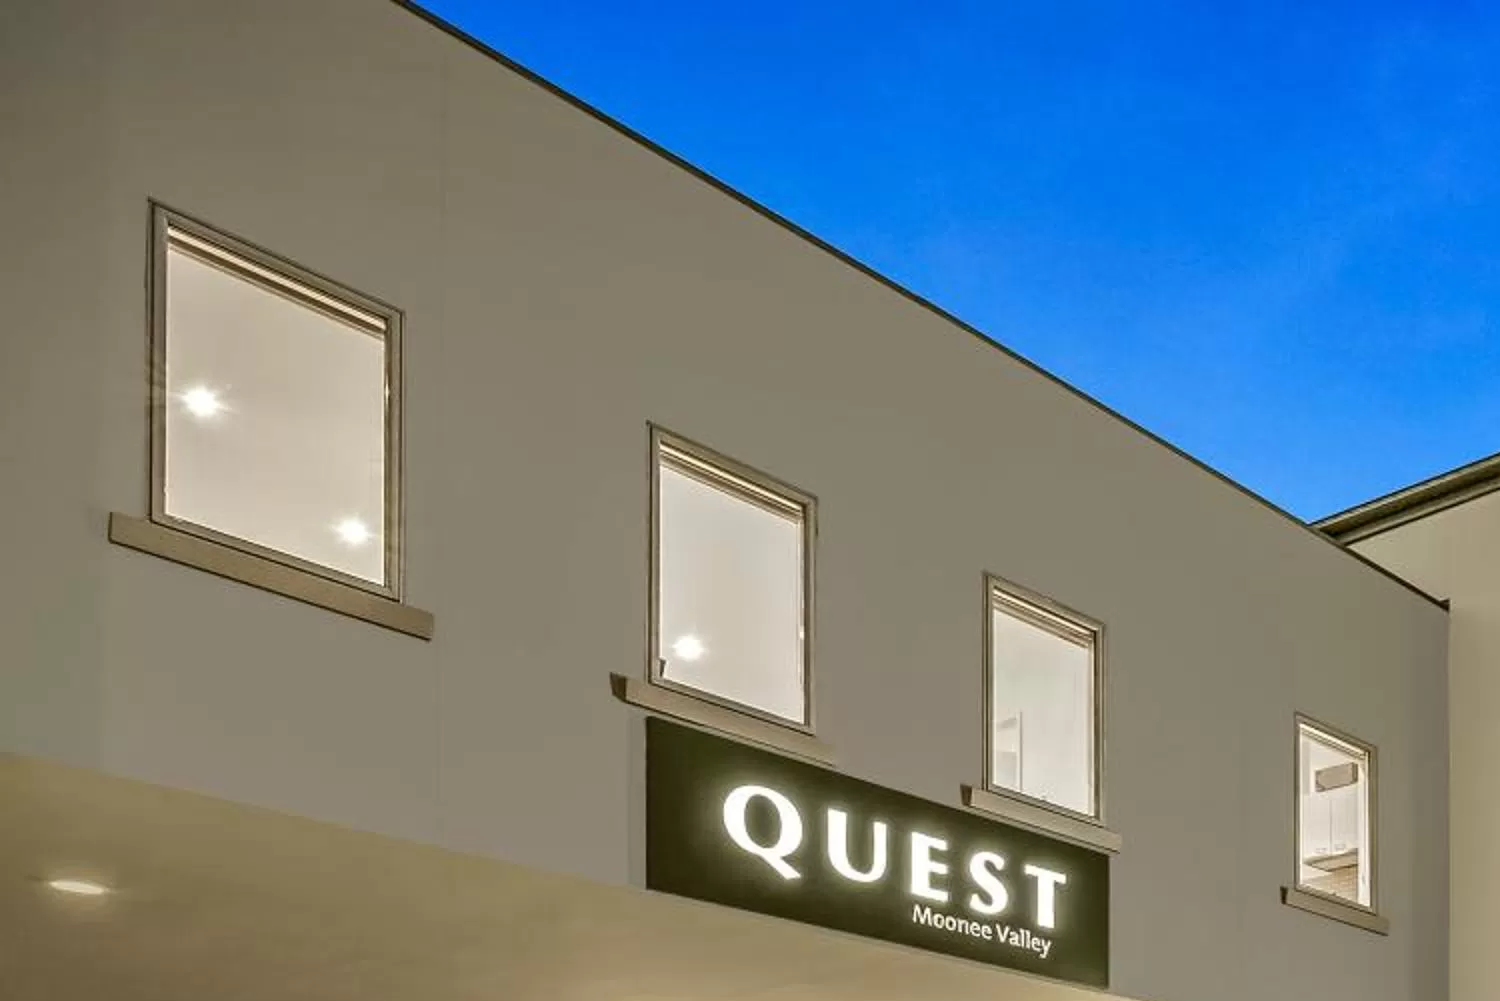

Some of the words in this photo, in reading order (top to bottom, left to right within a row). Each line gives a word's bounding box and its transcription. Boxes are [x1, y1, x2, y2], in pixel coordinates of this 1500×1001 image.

[722, 784, 1067, 928] QUEST
[912, 904, 993, 940] Moonee
[996, 924, 1052, 959] Valley
